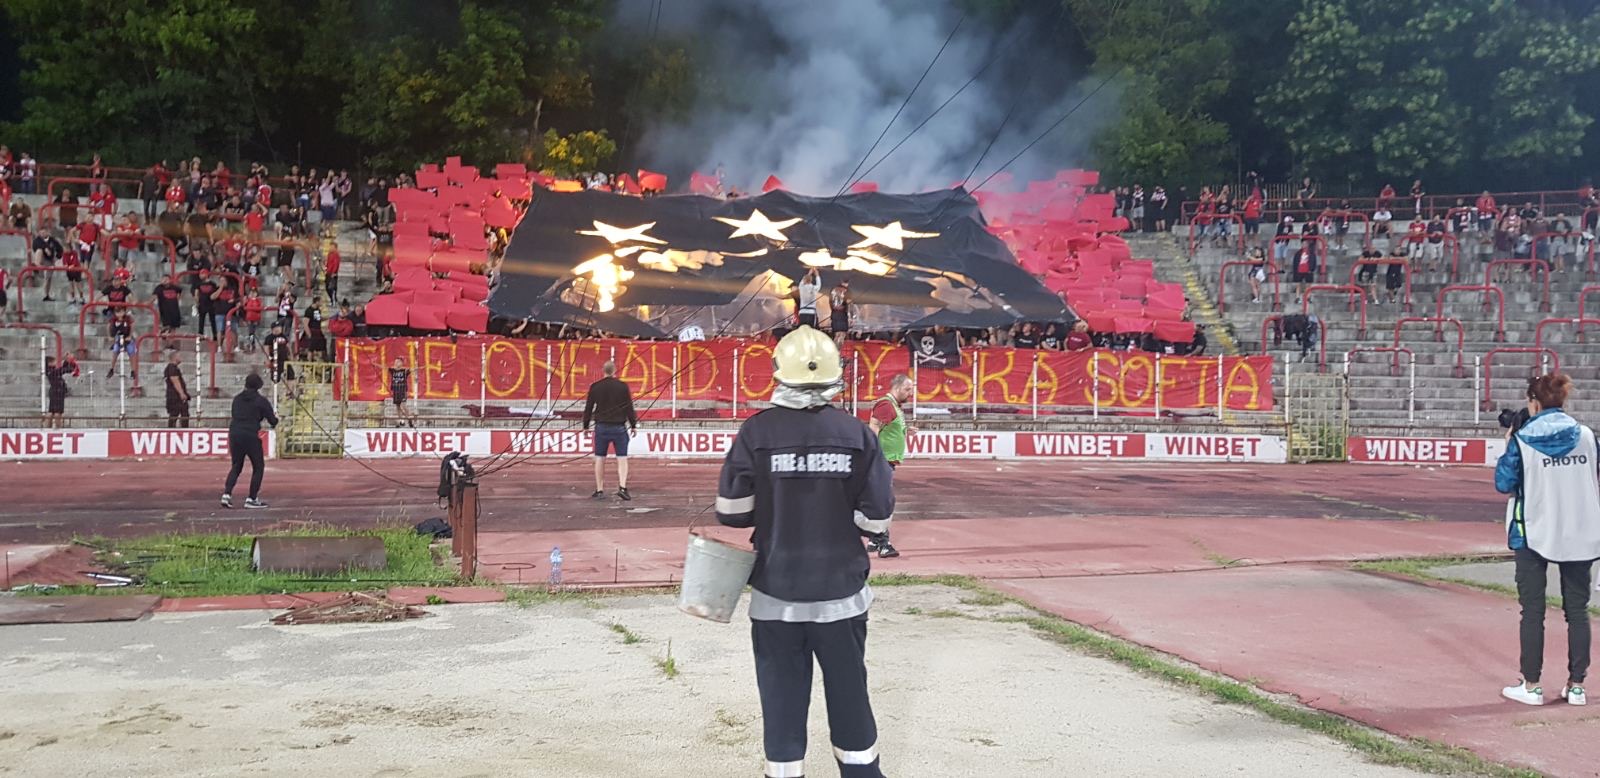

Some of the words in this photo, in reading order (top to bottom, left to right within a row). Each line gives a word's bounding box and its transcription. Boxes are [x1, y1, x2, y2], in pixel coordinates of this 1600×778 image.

[338, 340, 459, 398] THE
[486, 341, 599, 397] ONE
[618, 343, 718, 397] AND
[739, 344, 896, 400] OY
[1084, 353, 1260, 410] SOFIA
[1, 432, 84, 454] NBET
[131, 432, 229, 454] WINBE
[366, 432, 471, 452] WINBET
[510, 431, 593, 453] WINBE
[906, 434, 997, 454] WINBET
[1033, 435, 1128, 456] WINBET
[1165, 437, 1261, 457] WINBET
[1366, 439, 1468, 461] WINBET
[806, 453, 852, 473] RESCUE
[1543, 454, 1588, 468] PHOTO
